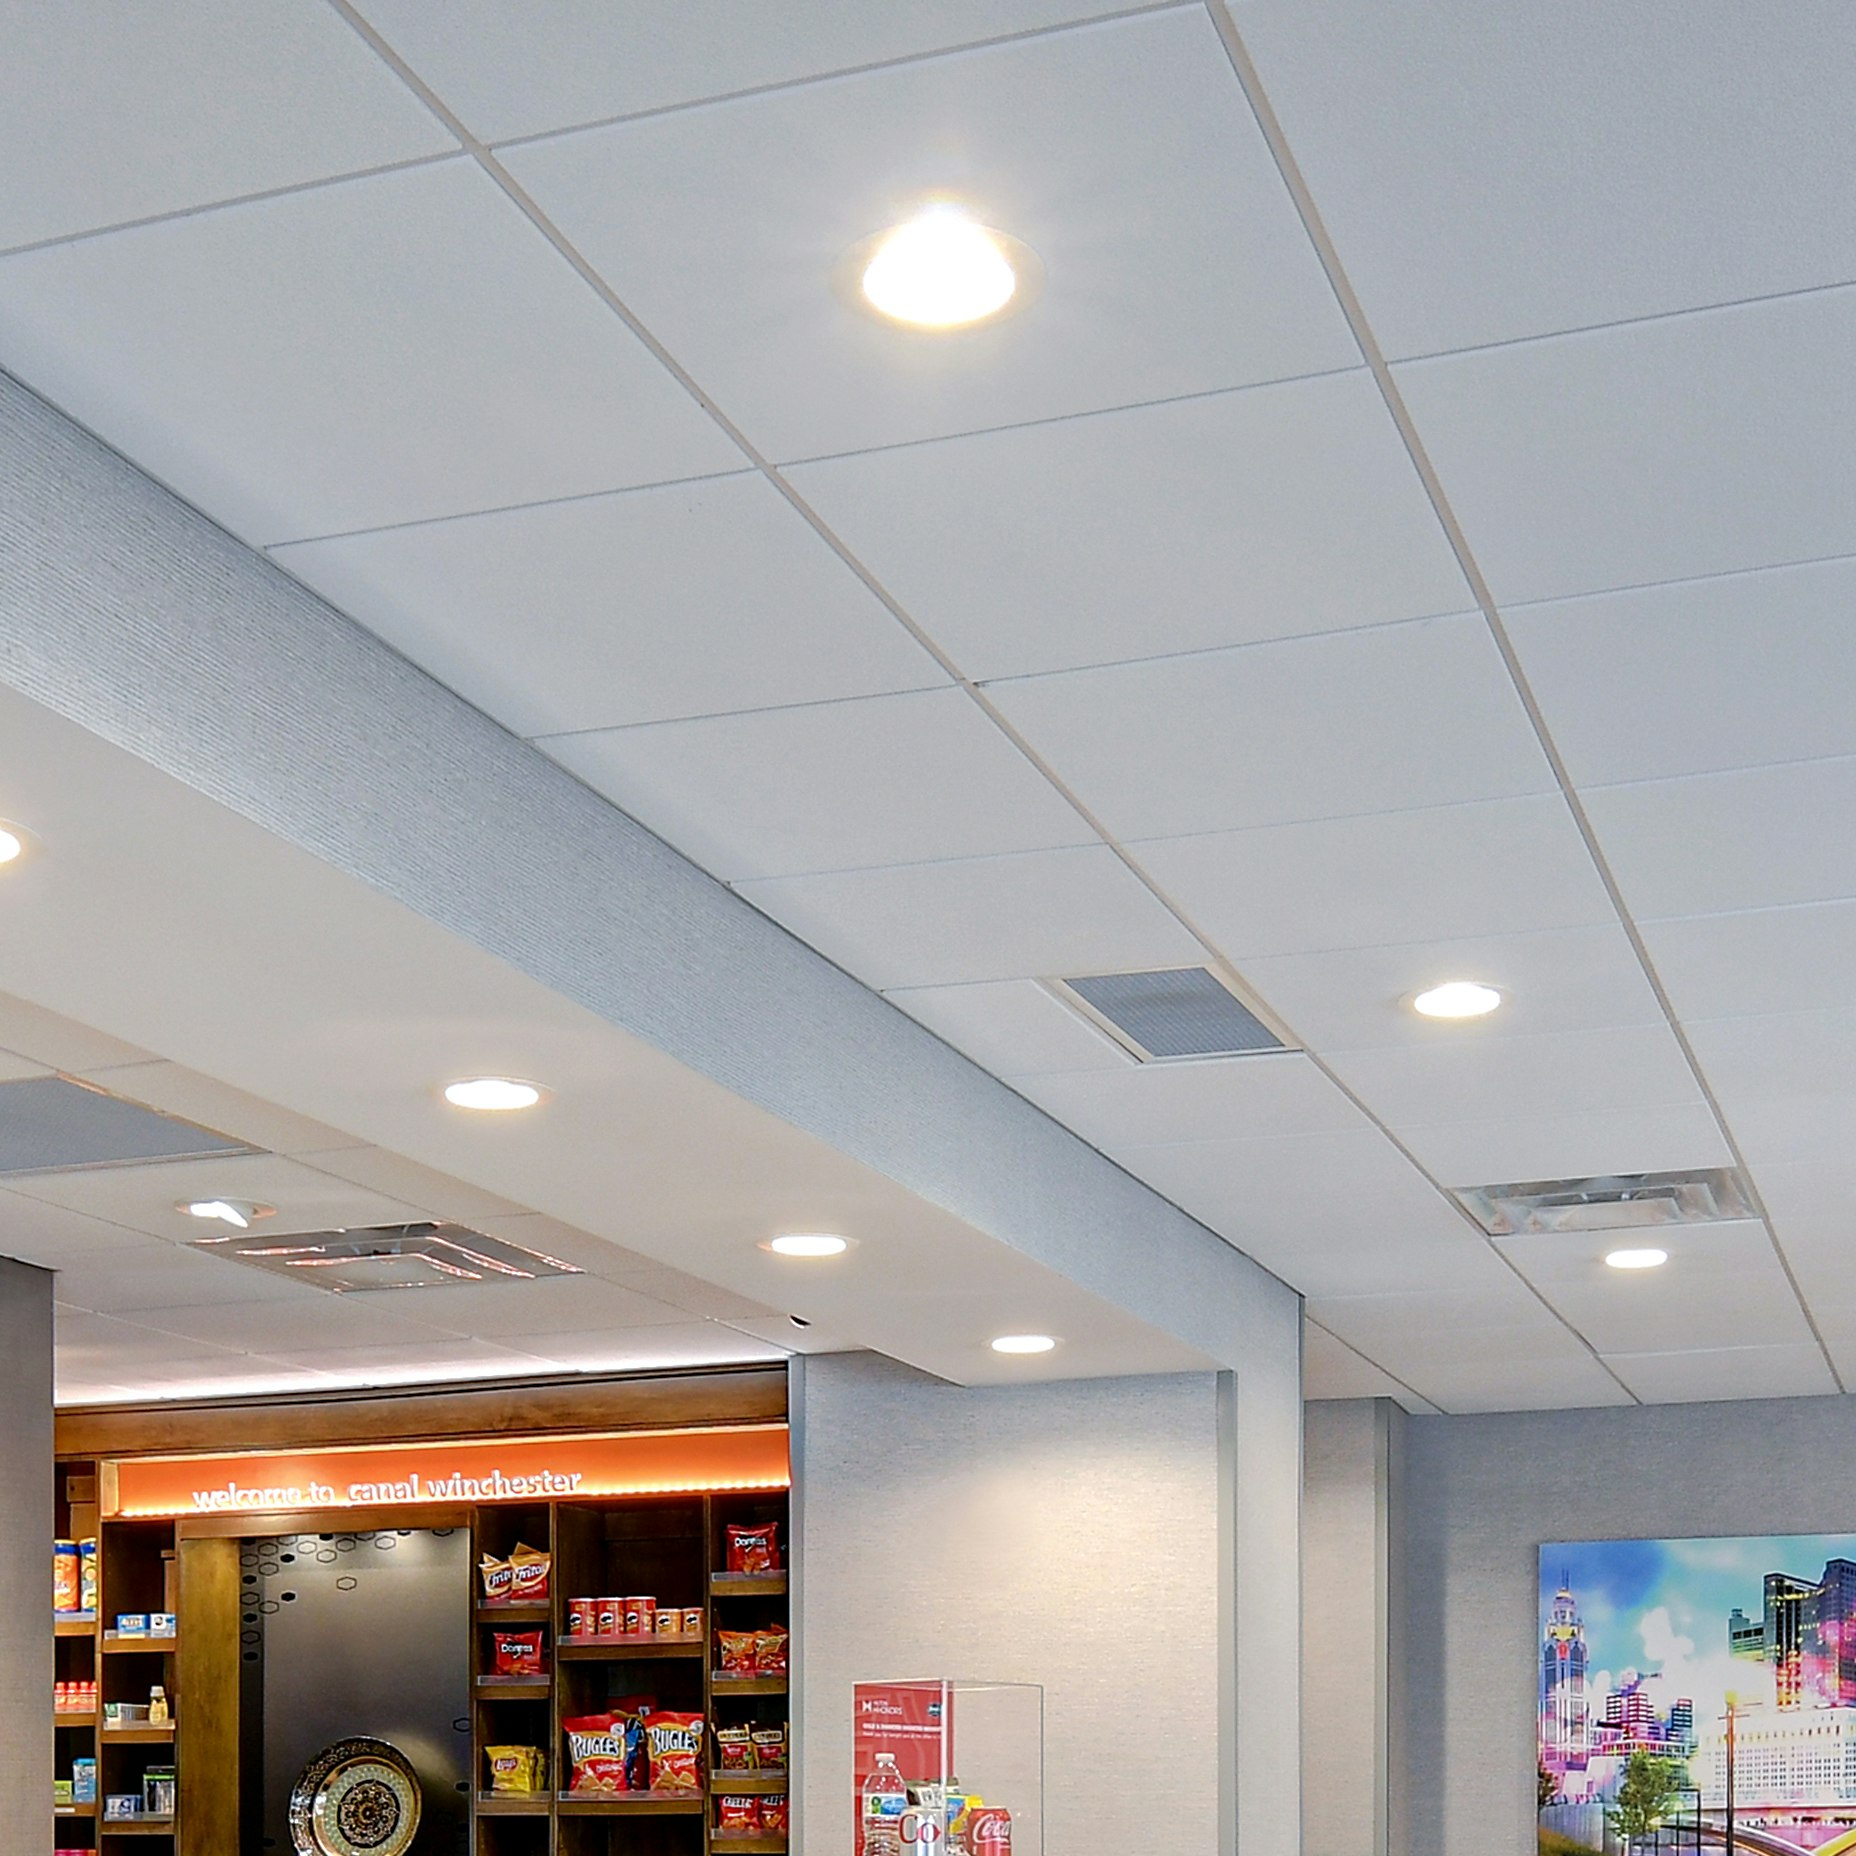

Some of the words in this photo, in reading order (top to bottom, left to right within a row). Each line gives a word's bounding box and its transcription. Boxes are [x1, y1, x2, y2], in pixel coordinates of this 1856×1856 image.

[191, 1481, 302, 1509] welcome
[308, 1481, 334, 1505] to
[347, 1474, 419, 1504] canal
[426, 1469, 582, 1500] winchester
[570, 1734, 621, 1762] BUGLES
[651, 1727, 697, 1756] BUGLES
